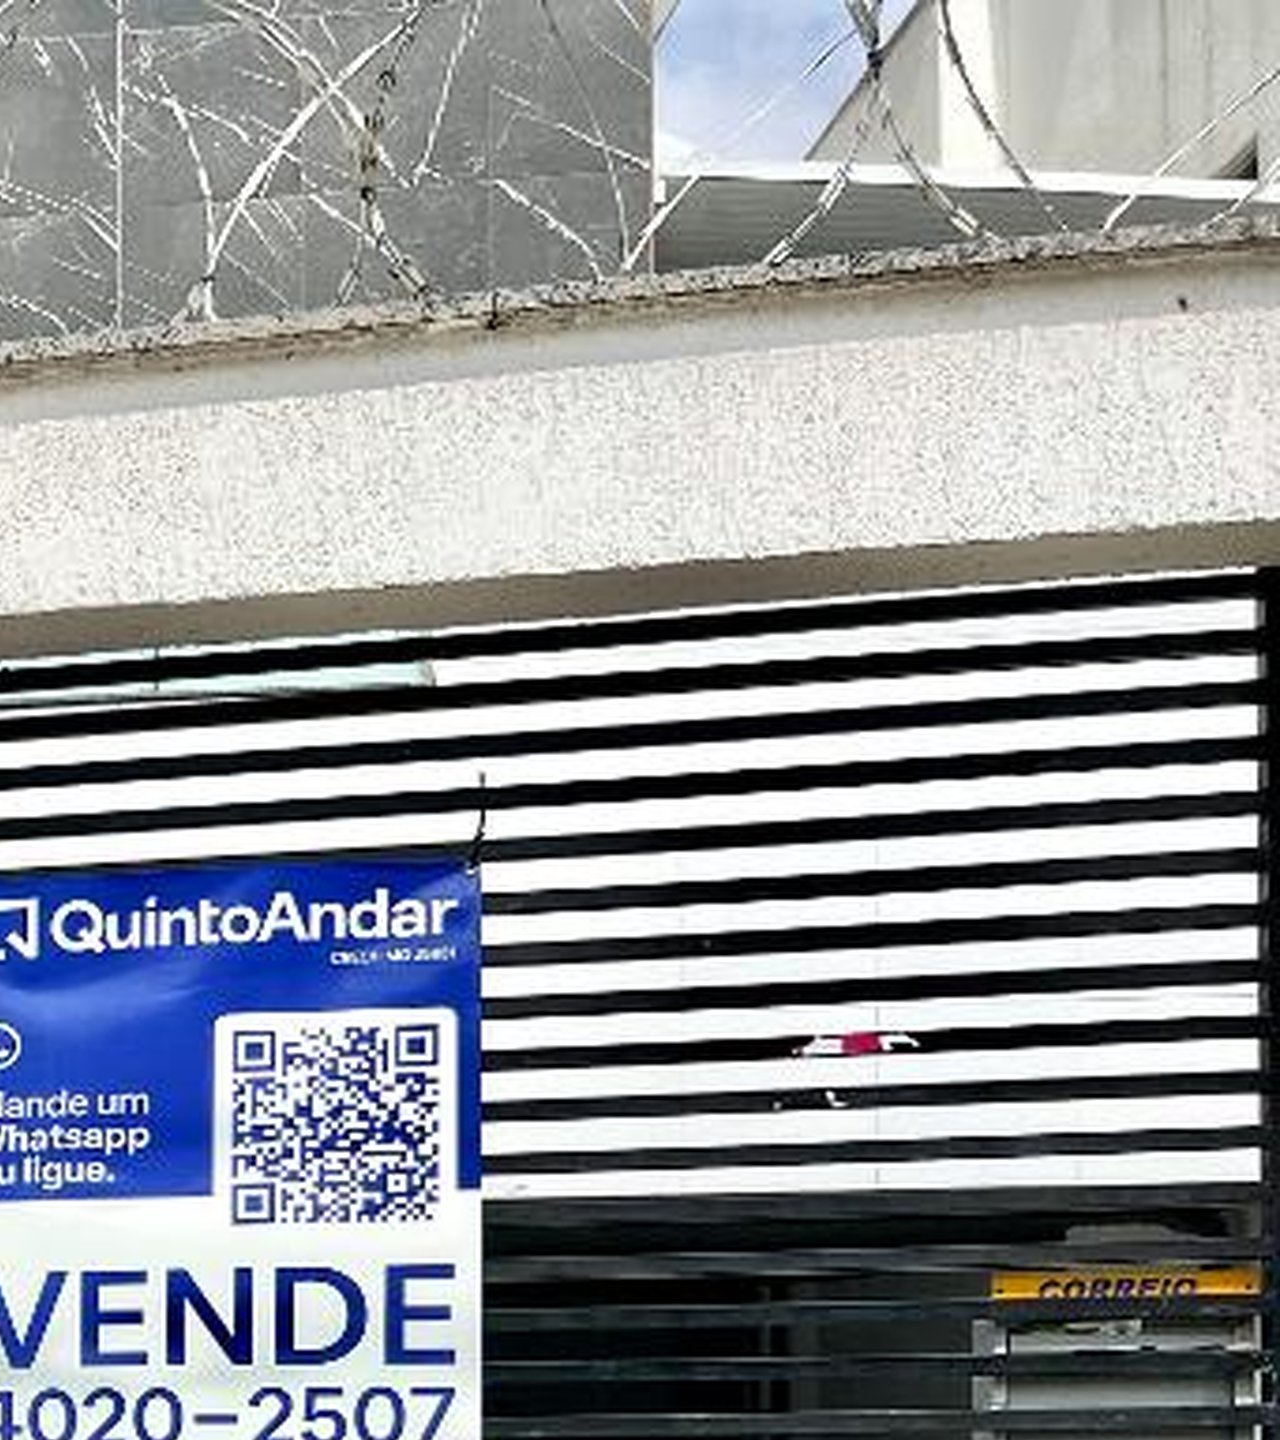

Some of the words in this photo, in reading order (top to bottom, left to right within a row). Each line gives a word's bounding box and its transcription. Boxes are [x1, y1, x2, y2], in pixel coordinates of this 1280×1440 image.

[49, 888, 458, 953] QuintoAndar
[96, 1092, 150, 1116] um
[23, 1155, 116, 1190] ligue.
